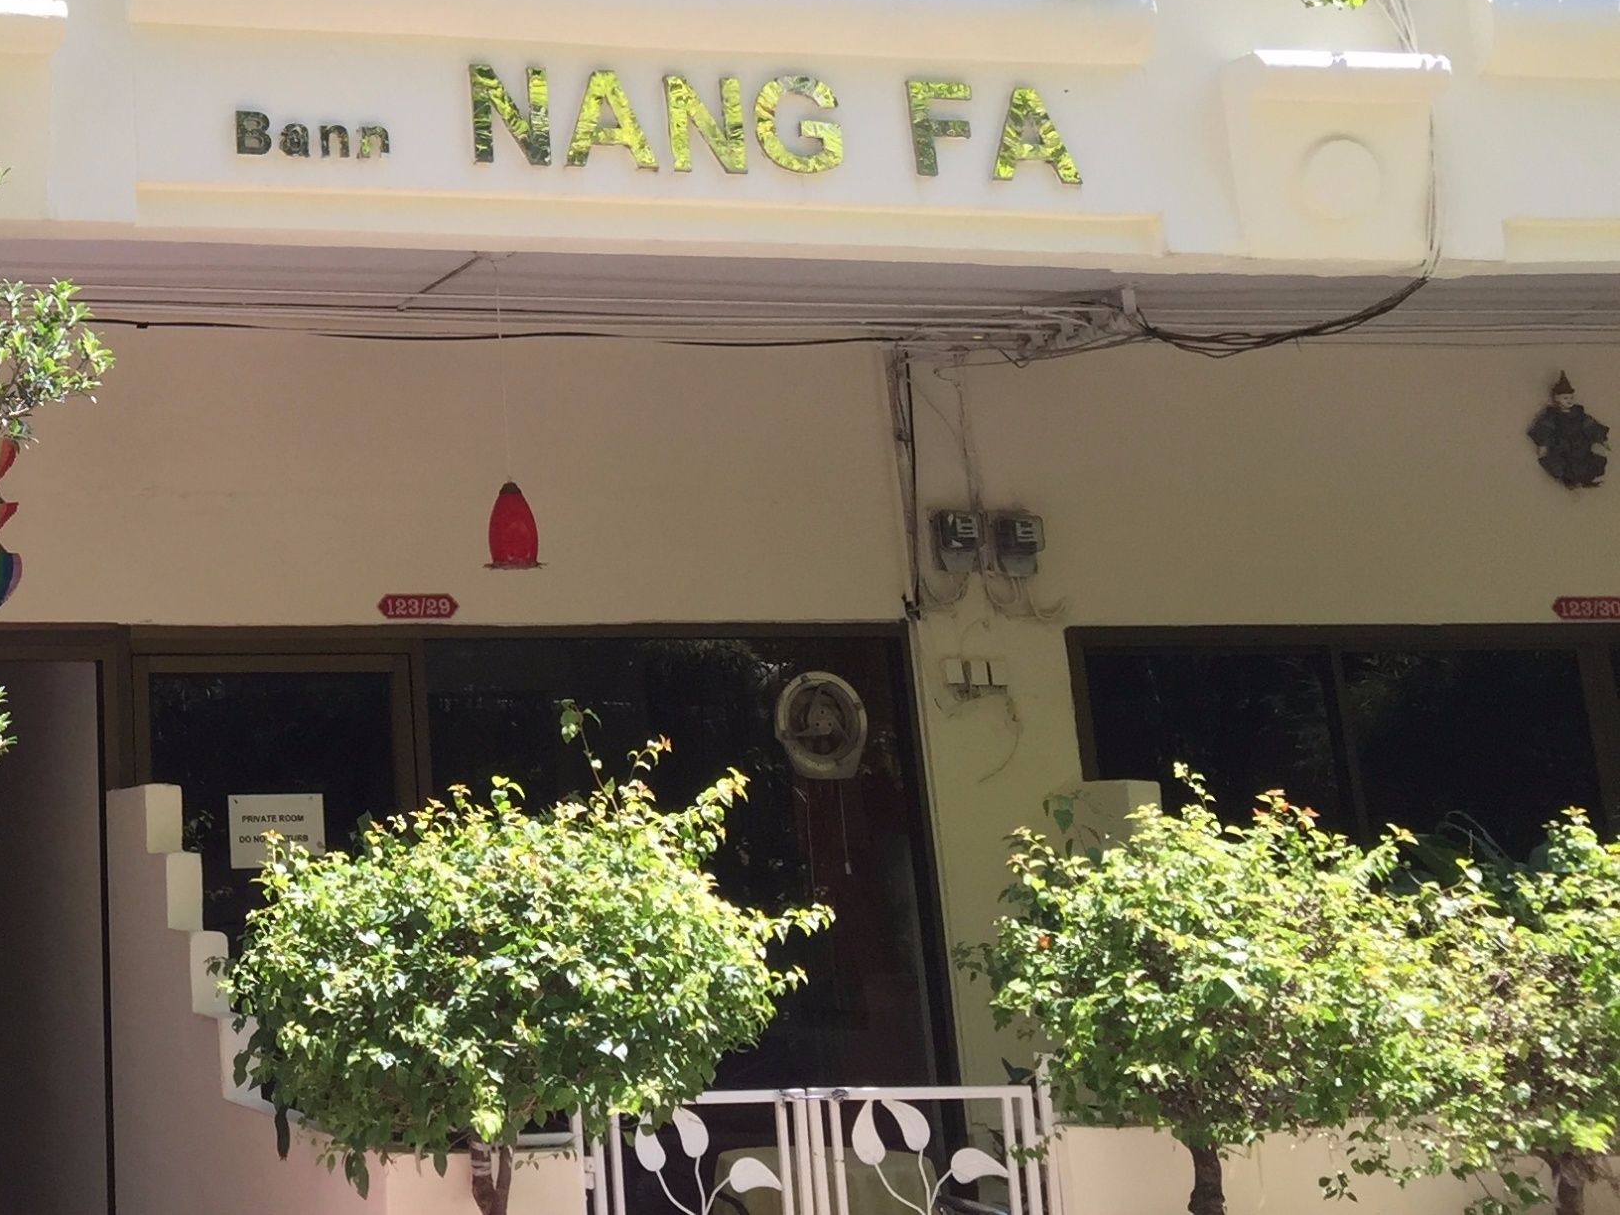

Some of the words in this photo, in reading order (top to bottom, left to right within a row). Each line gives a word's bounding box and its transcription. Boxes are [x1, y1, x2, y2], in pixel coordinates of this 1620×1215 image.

[234, 109, 392, 161] Bann
[468, 63, 847, 176] NANG
[904, 78, 1085, 187] FA
[386, 597, 451, 616] 123/29
[241, 814, 277, 824] PRIVATE
[278, 814, 304, 823] ROOM
[239, 835, 252, 843] DO
